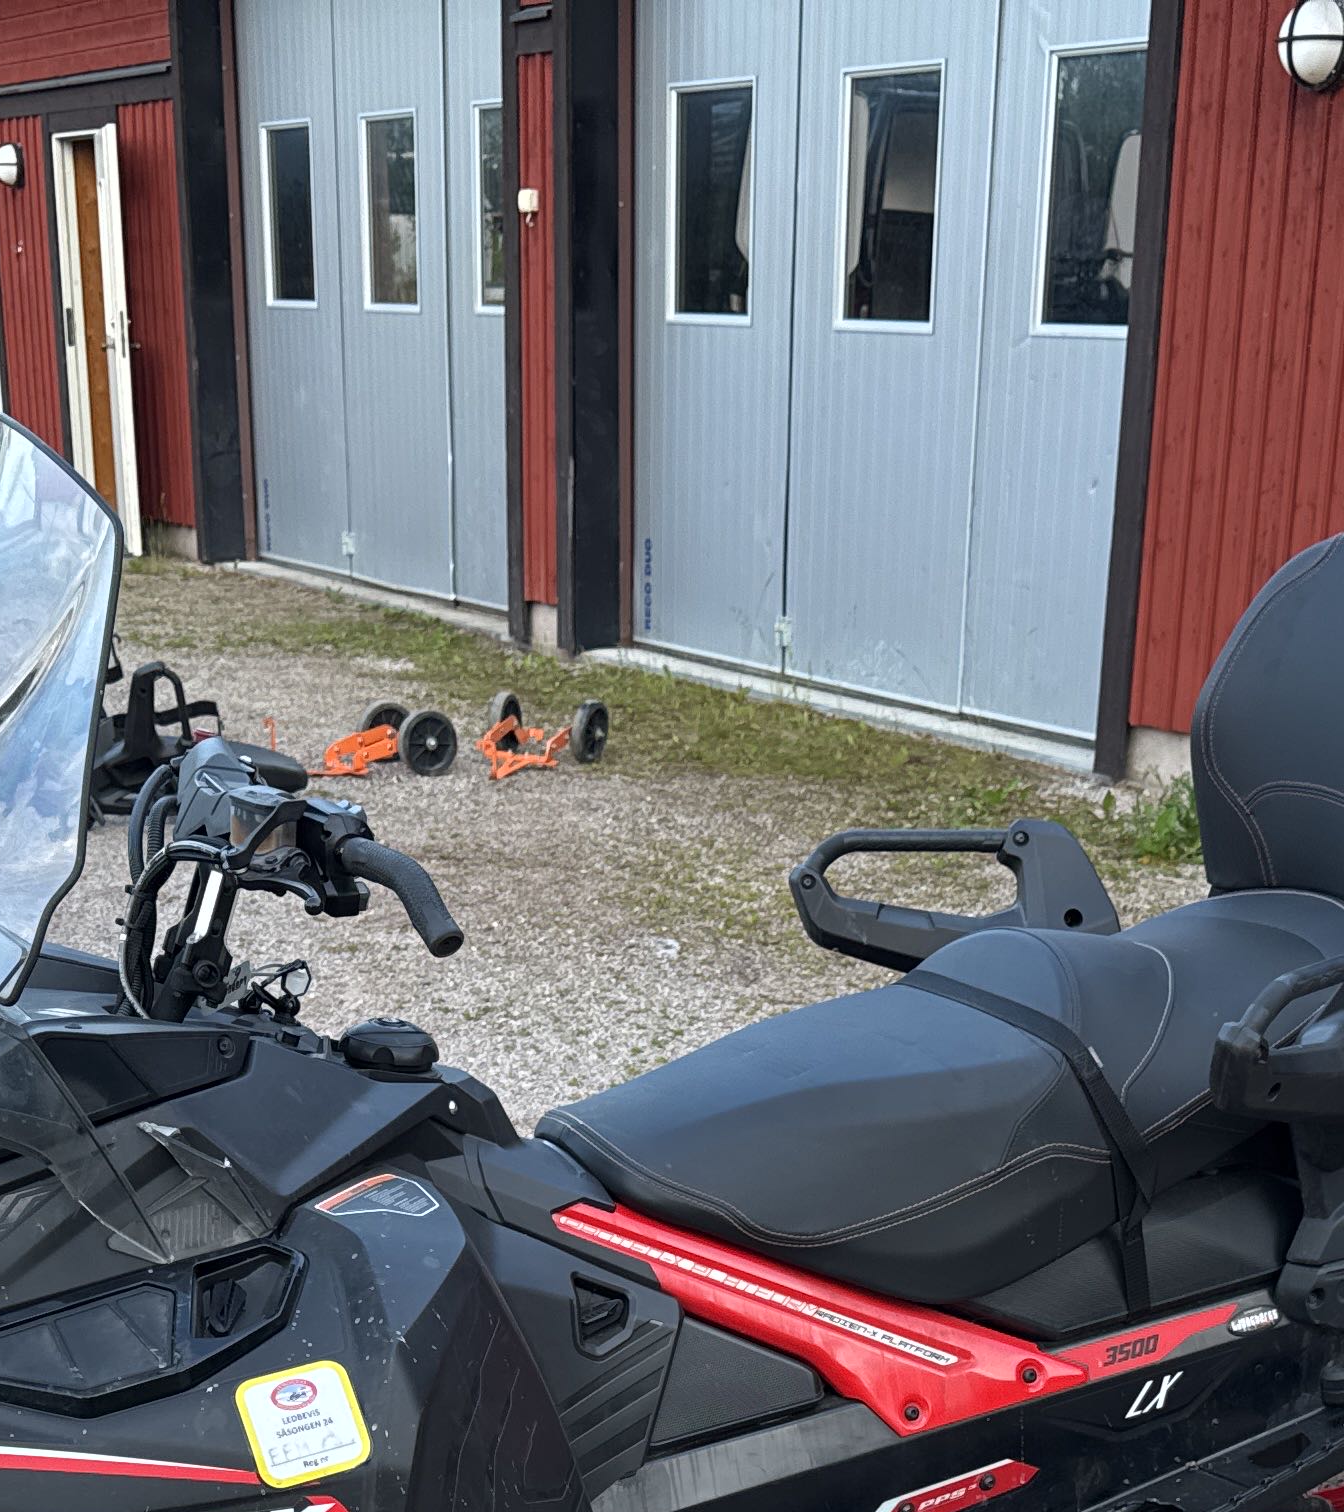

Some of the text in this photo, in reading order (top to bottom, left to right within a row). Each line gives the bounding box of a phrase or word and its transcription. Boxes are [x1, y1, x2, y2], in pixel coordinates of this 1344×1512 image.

[814, 1309, 952, 1364] RADIEN-X PLATFORM
[1104, 1334, 1160, 1367] 3500
[1124, 1370, 1185, 1420] LX
[281, 1408, 321, 1426] LEDBEVIS
[303, 1459, 319, 1468] Reg
